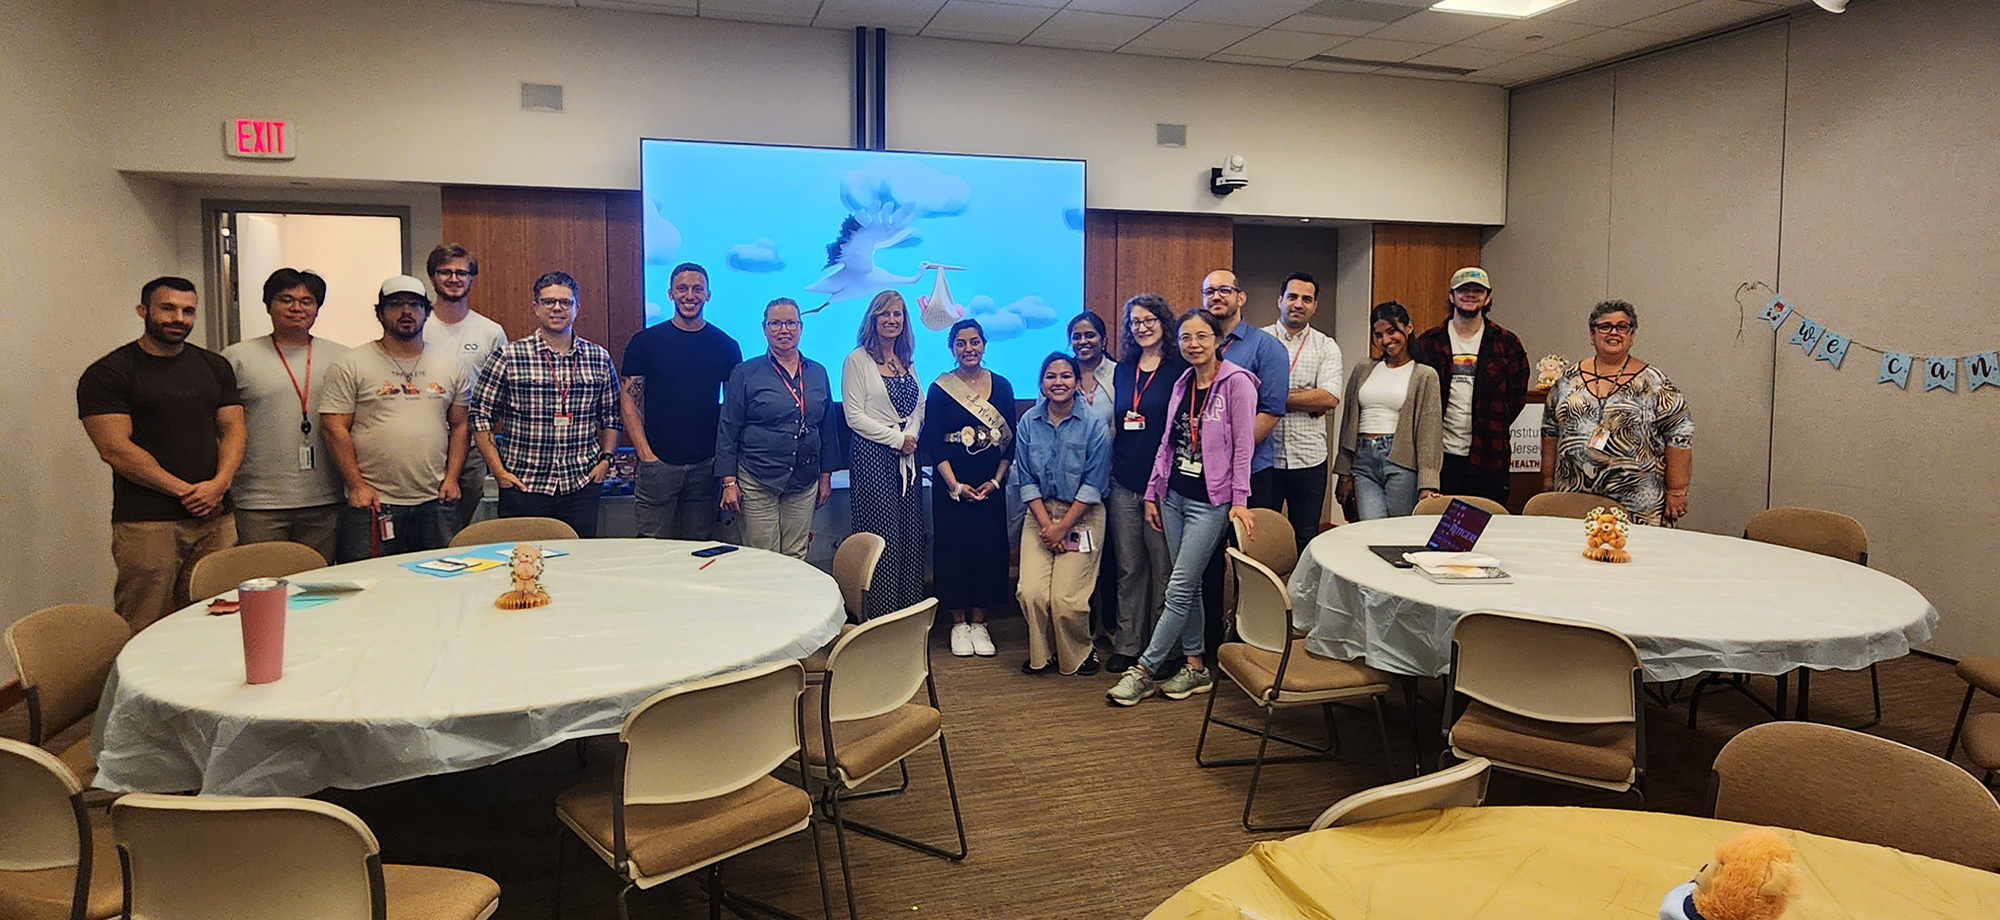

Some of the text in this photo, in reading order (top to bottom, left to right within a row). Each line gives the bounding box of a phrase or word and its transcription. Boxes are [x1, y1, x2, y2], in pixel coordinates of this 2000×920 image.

[236, 119, 286, 153] EXIT
[1799, 323, 1993, 381] we can
[1510, 427, 1540, 438] nstitu
[1511, 442, 1541, 454] Jerse
[1510, 459, 1540, 468] HEALTH
